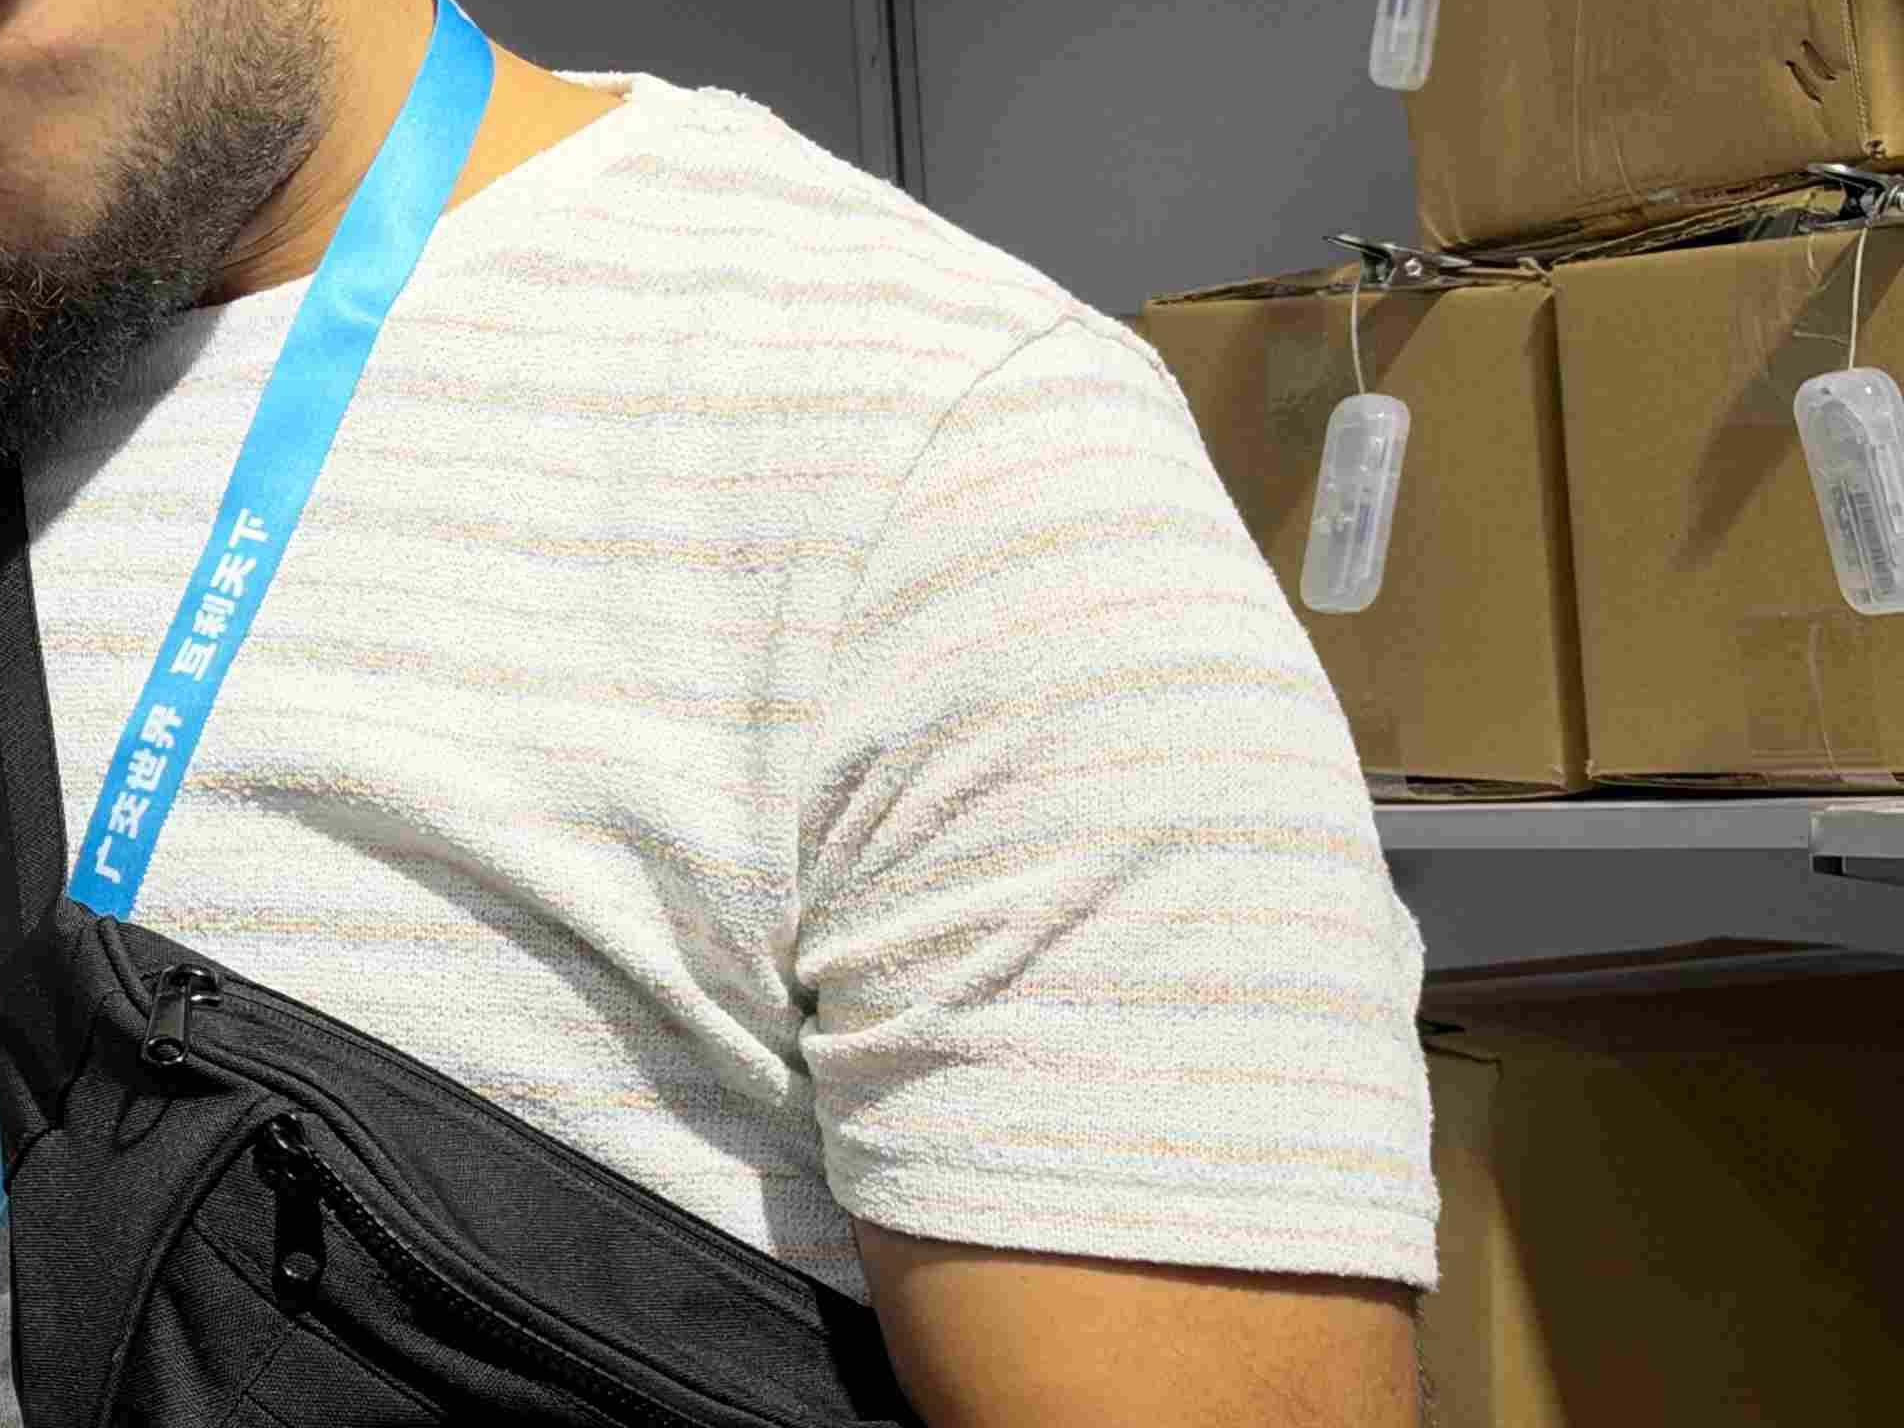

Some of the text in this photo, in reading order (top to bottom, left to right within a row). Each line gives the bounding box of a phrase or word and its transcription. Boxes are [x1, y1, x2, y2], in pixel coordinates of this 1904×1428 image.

[94, 507, 270, 884] 广交世界 互利天下
